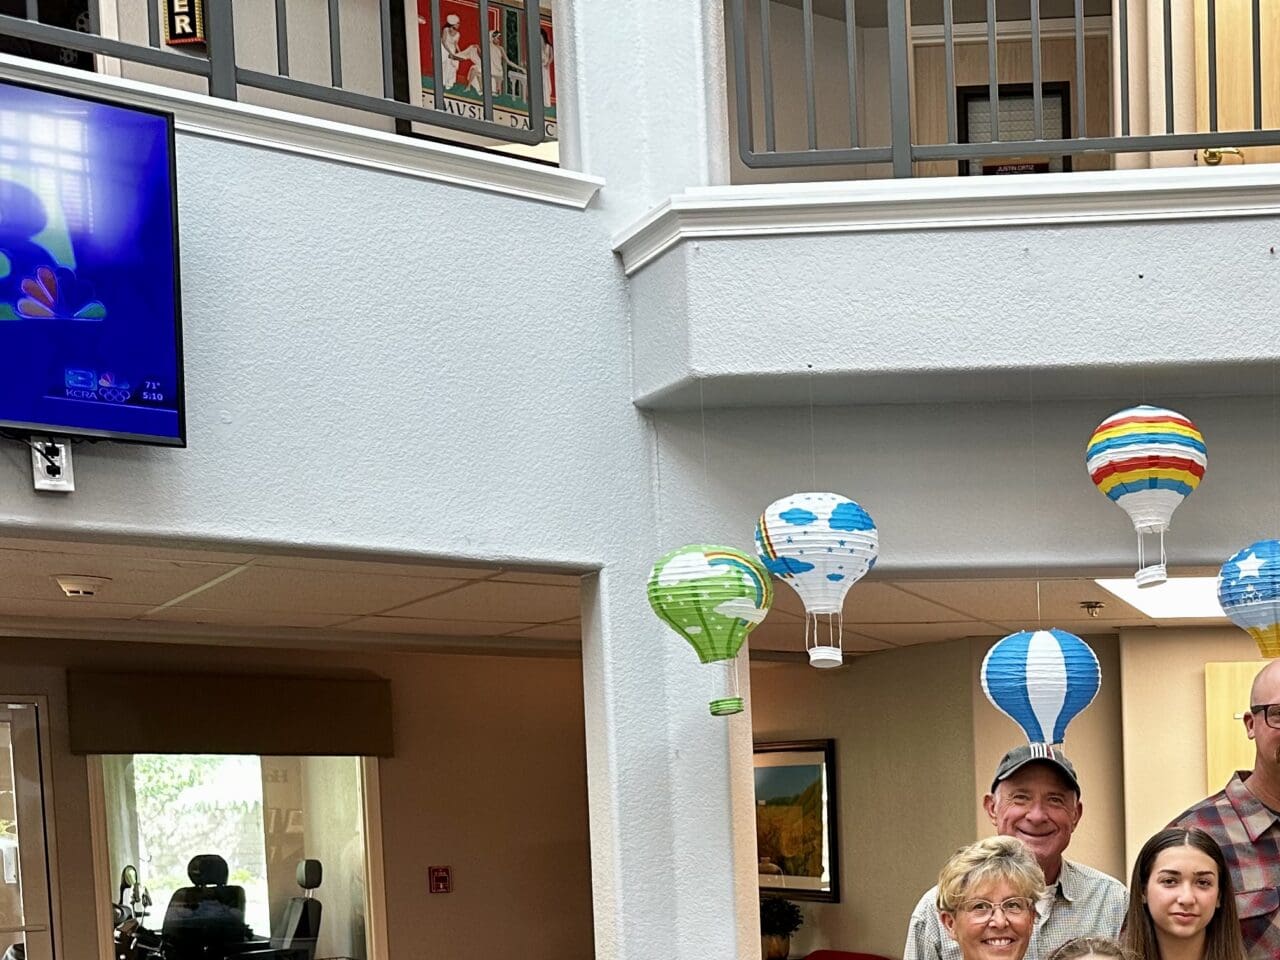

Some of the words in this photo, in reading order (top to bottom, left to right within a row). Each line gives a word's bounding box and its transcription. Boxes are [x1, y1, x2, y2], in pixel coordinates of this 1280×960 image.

[444, 101, 486, 121] MUSI
[510, 115, 555, 136] DAC
[66, 389, 98, 400] KCRA
[143, 391, 164, 401] 5:10
